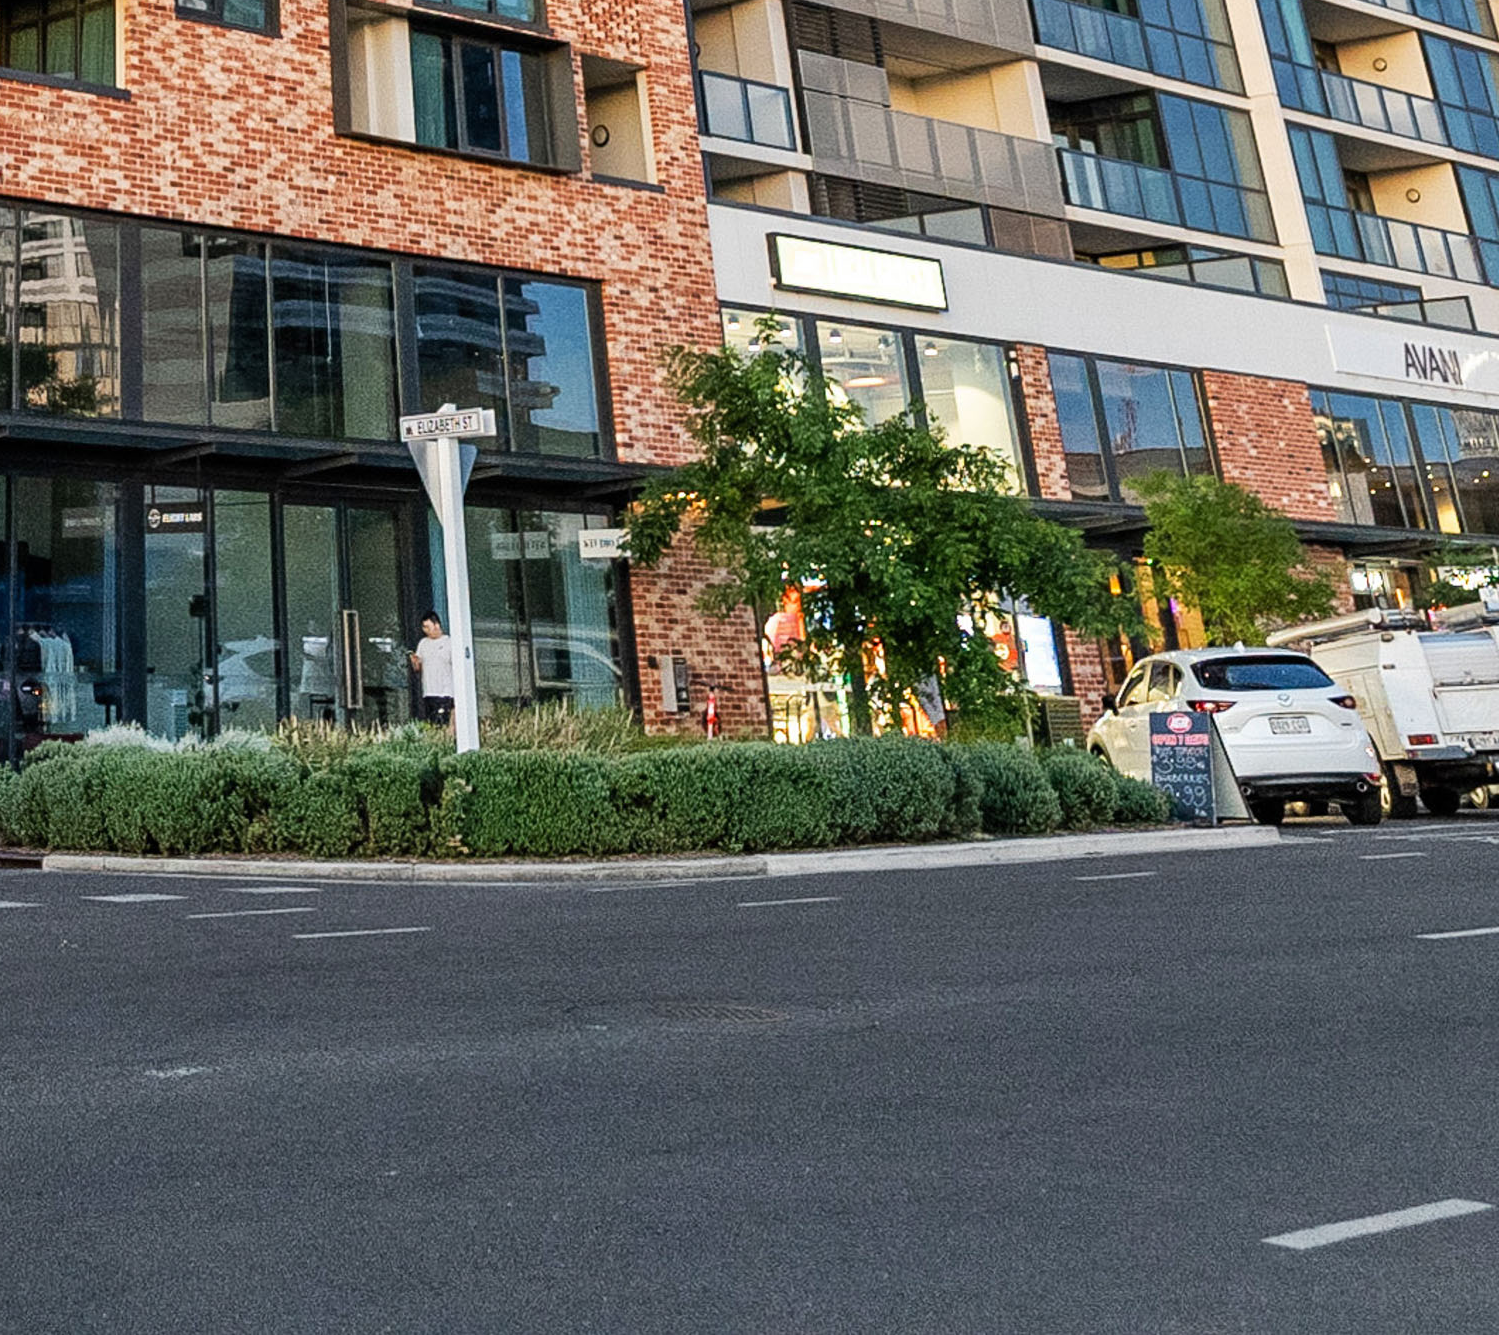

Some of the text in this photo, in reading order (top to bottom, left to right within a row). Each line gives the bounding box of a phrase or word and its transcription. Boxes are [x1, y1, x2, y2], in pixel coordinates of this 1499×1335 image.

[1403, 341, 1464, 386] AVANI
[417, 415, 473, 435] ELIZABETH ST
